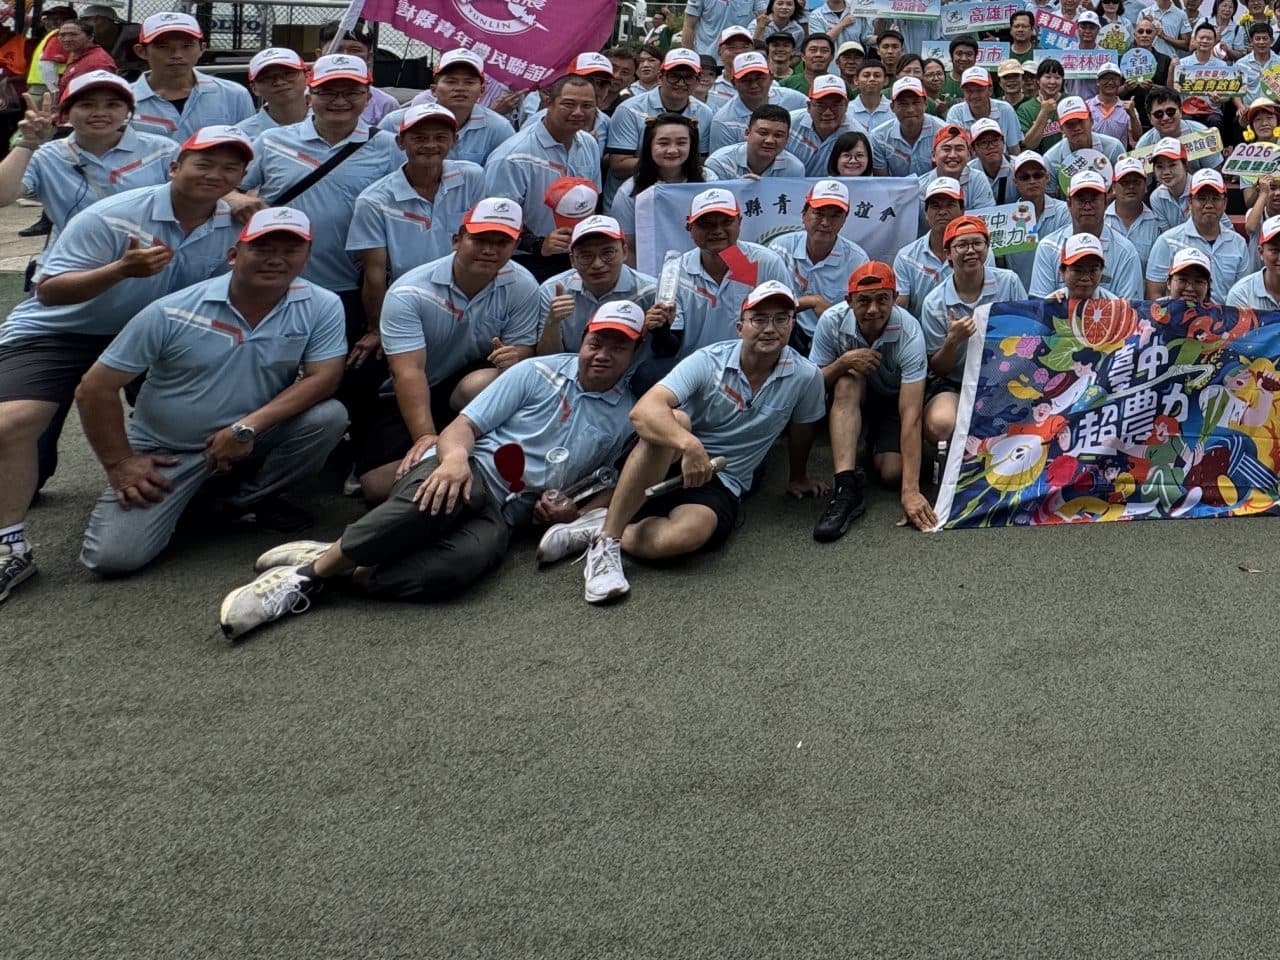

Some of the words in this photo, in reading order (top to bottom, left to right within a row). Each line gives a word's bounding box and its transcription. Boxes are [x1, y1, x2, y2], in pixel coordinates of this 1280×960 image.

[466, 8, 511, 29] YUNLIN
[968, 4, 1017, 24] 高雄市
[1061, 54, 1111, 71] 雲林縣
[1236, 145, 1273, 157] 2026
[1072, 382, 1189, 457] 超農力
